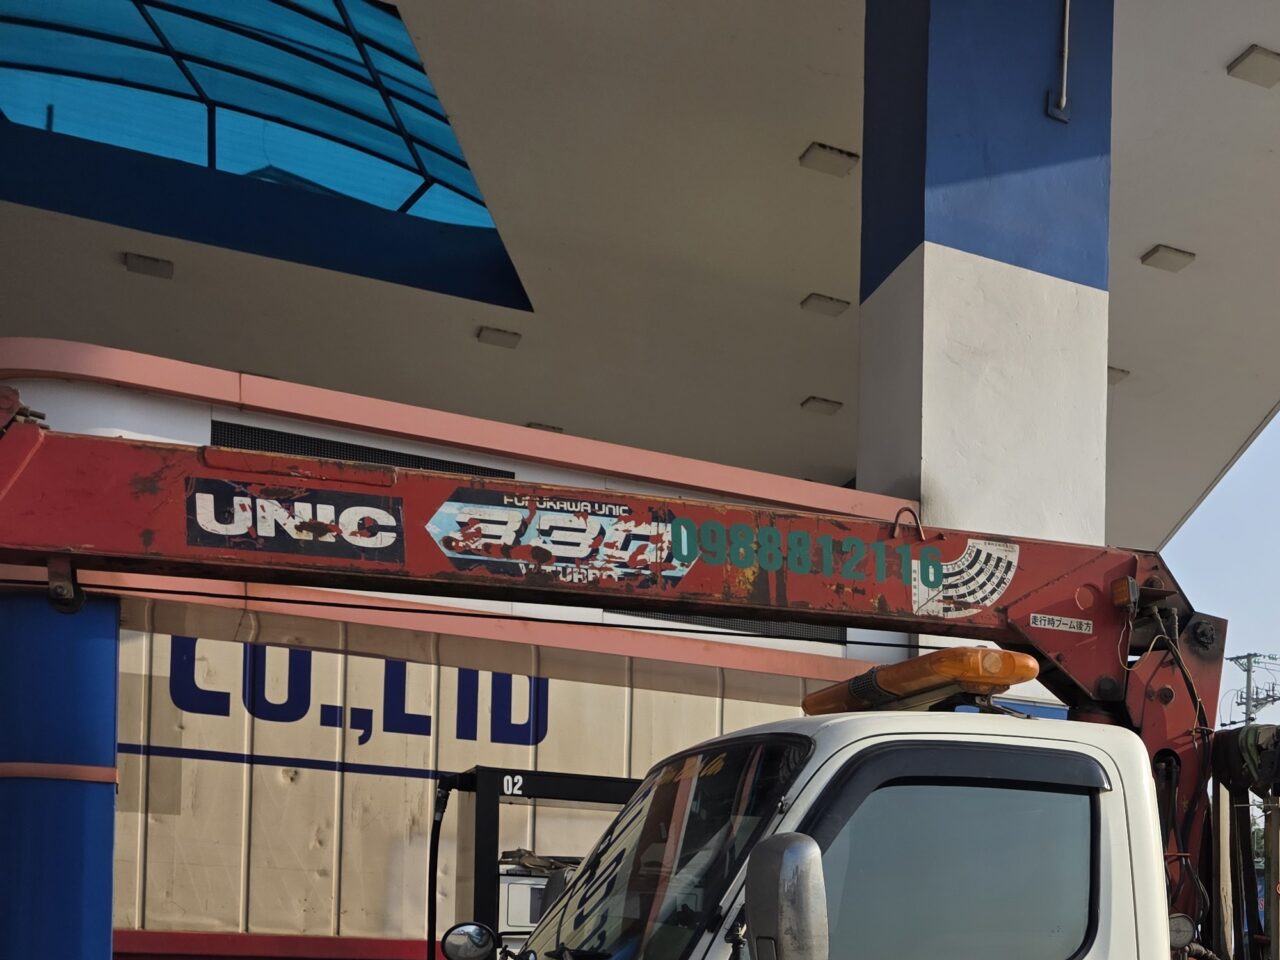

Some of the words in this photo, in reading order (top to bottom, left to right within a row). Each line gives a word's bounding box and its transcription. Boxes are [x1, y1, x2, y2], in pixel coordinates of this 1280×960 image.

[195, 493, 397, 549] UNIC
[670, 517, 944, 589] 0988812116
[1030, 614, 1093, 633] 走行時ブーム後方
[503, 775, 523, 795] 02
